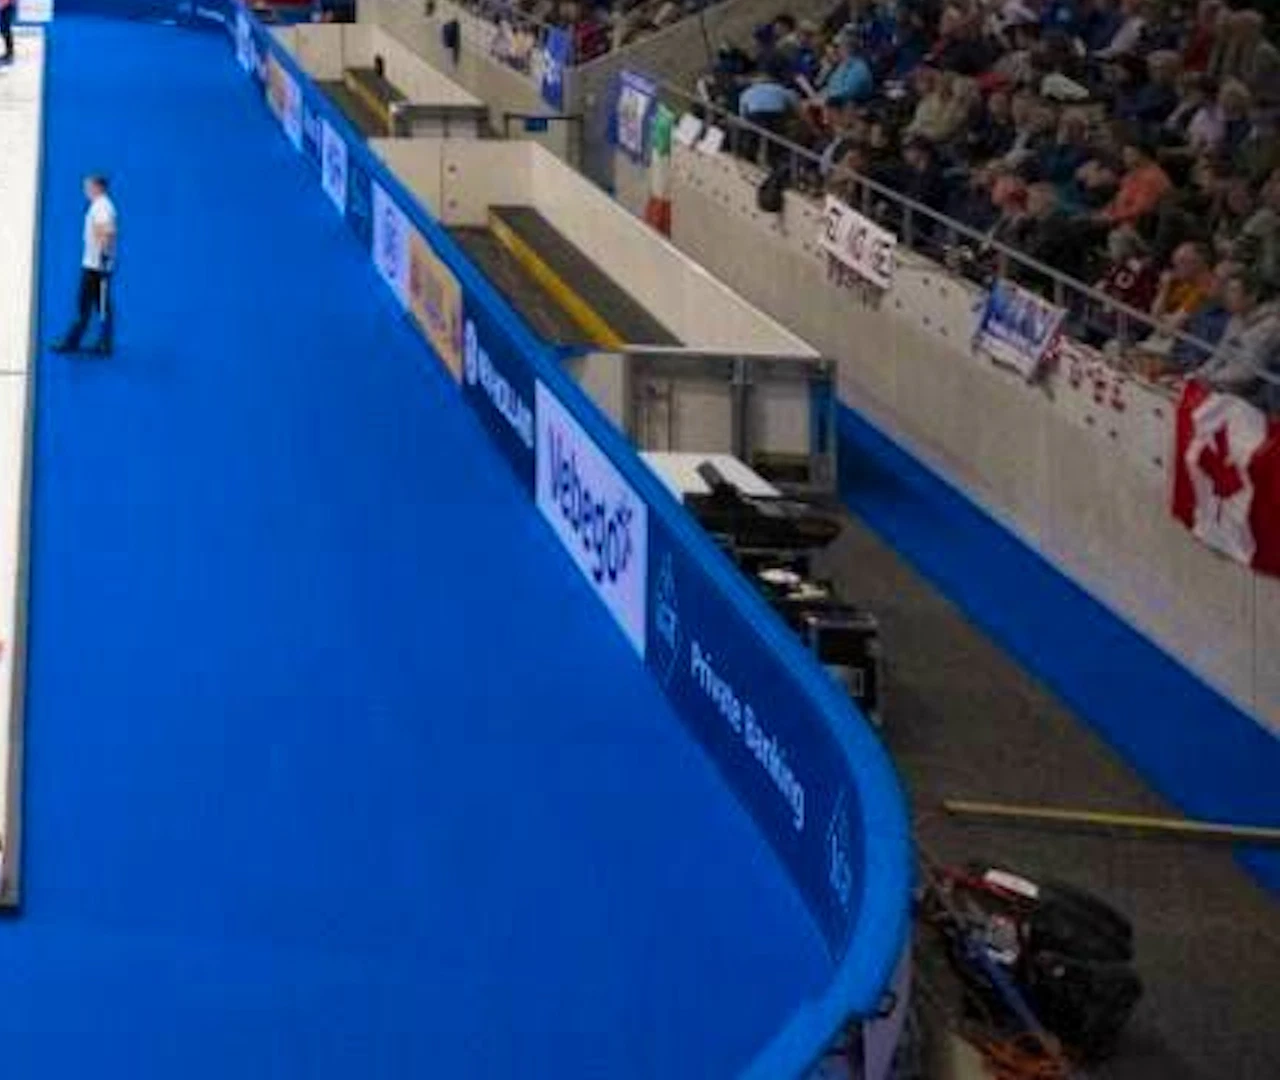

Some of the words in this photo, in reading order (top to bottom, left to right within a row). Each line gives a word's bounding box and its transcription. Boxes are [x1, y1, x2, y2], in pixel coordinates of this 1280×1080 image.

[549, 422, 631, 584] Vebego
[691, 640, 742, 734] Private
[744, 703, 805, 833] Banking
